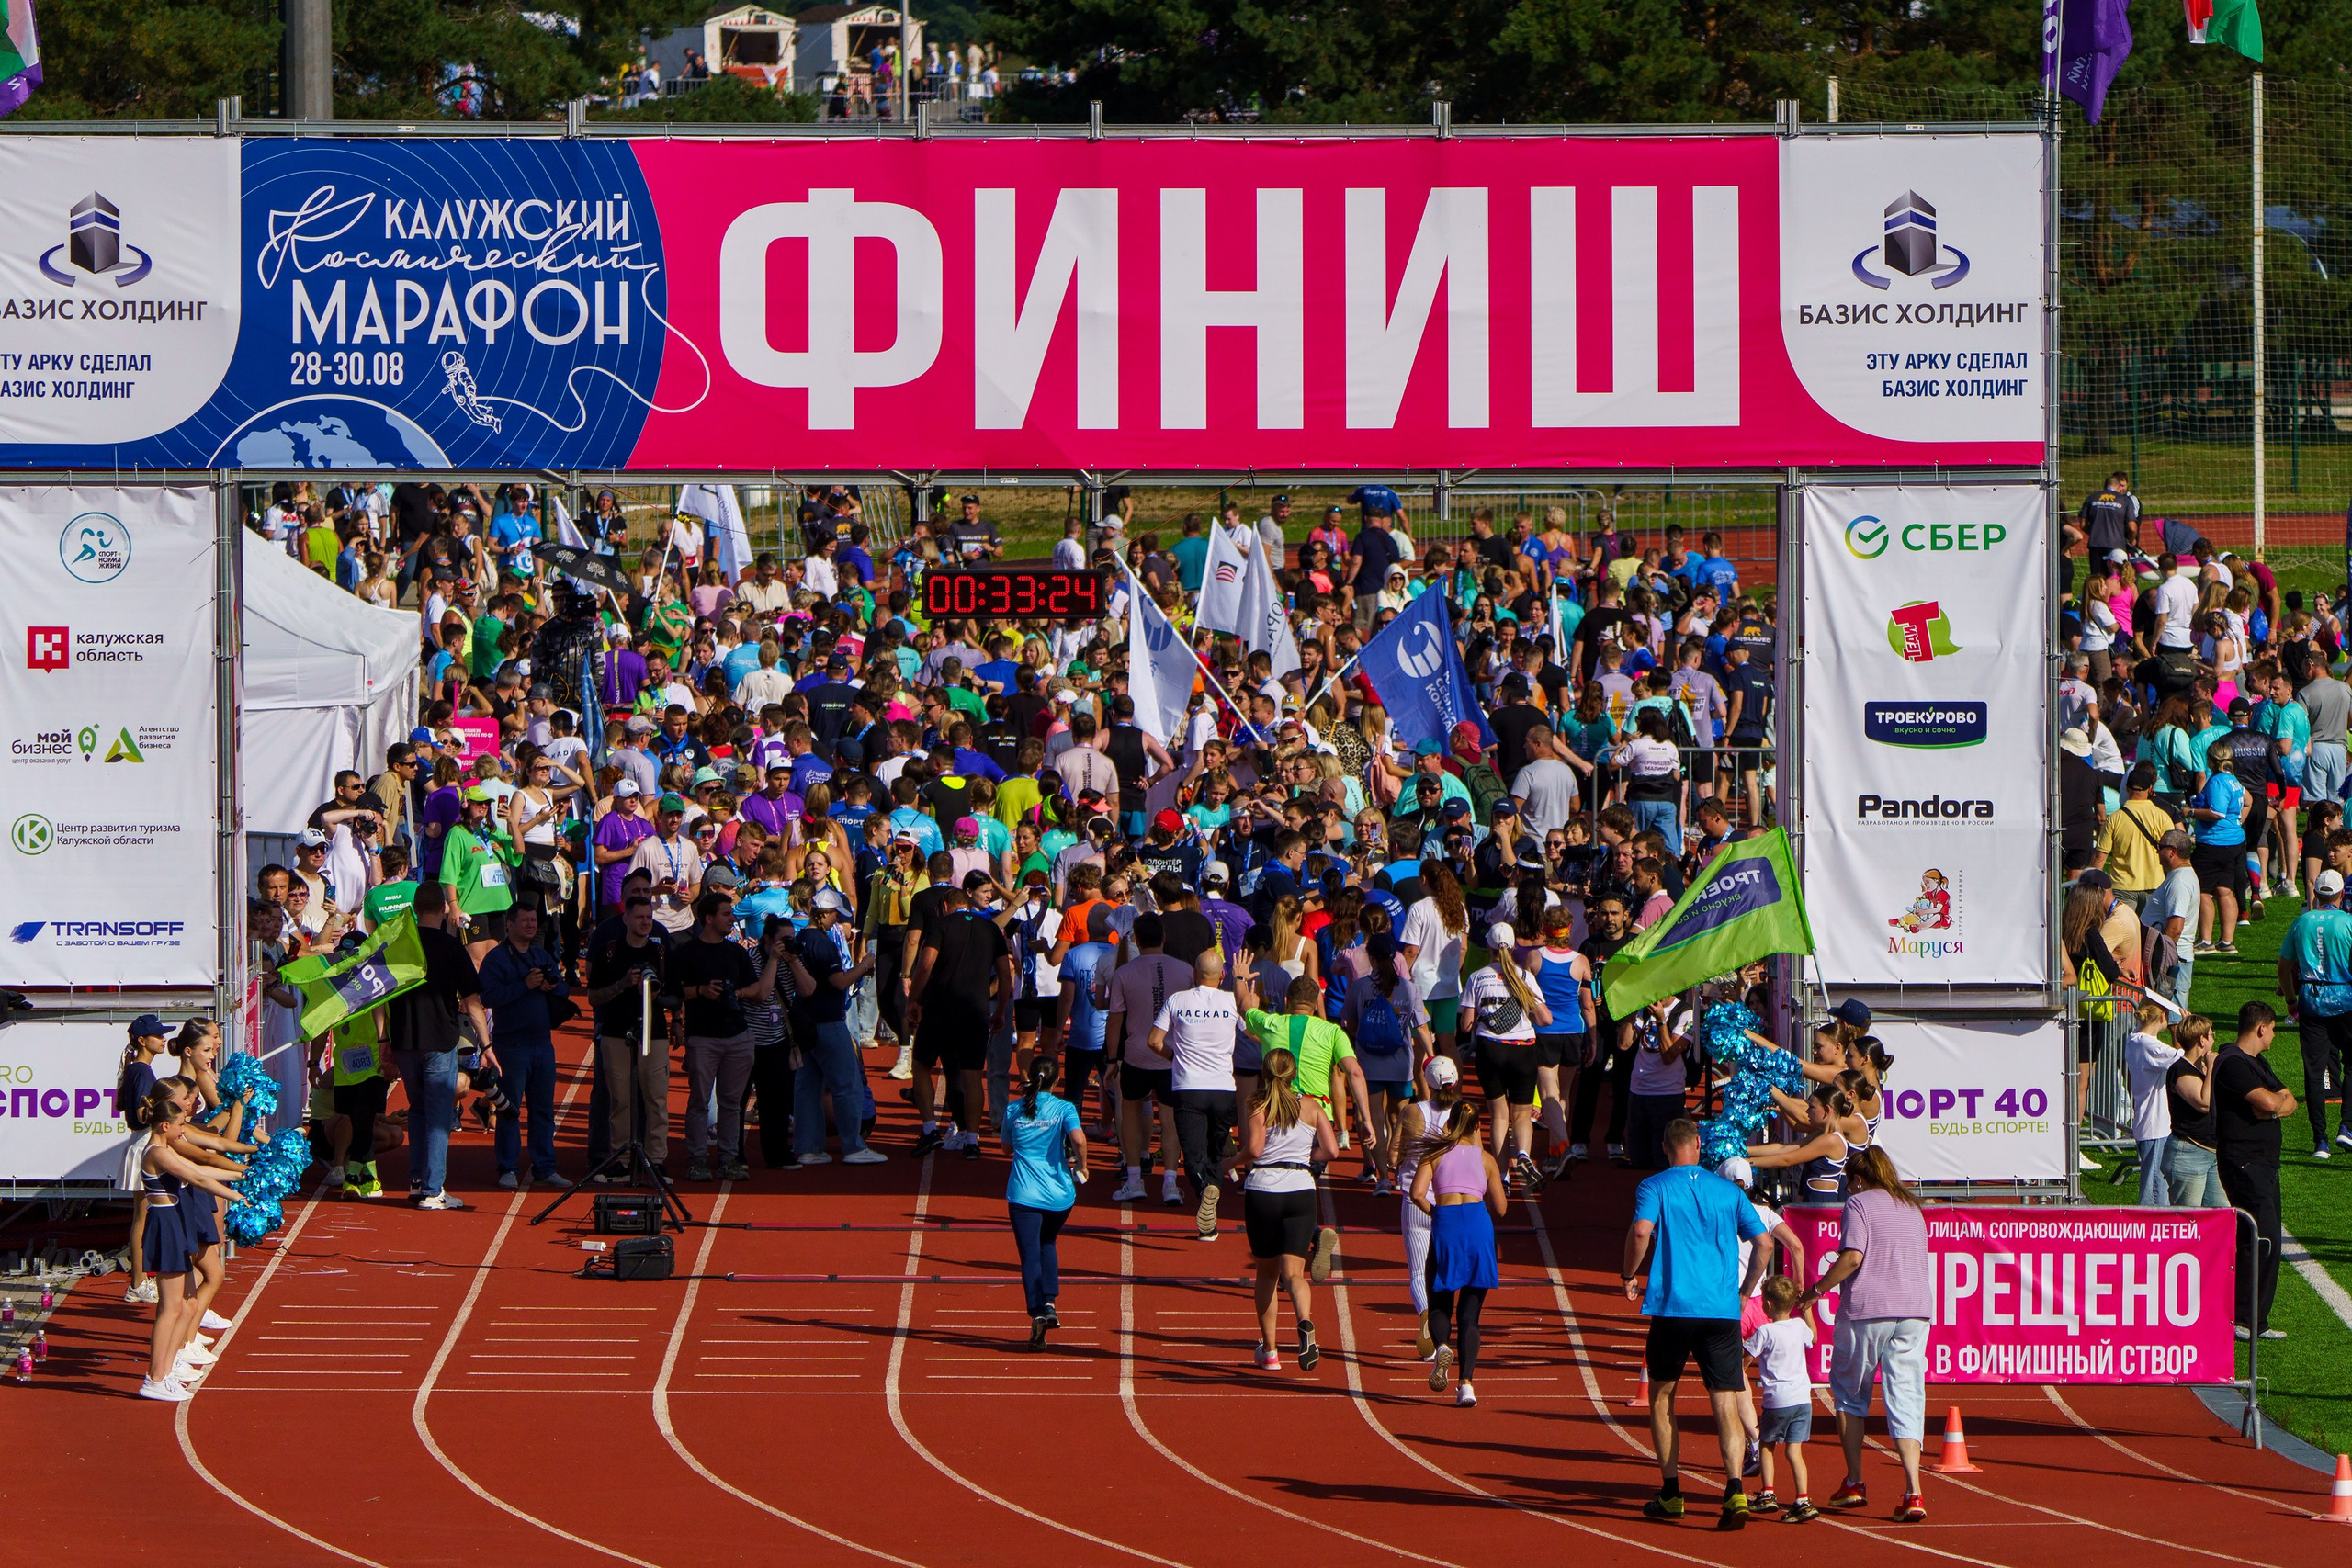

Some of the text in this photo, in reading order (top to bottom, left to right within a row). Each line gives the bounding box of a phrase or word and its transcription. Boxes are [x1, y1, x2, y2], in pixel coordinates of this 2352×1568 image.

[385, 194, 629, 241] КАЛУЖСКИЙ
[81, 300, 208, 325] ХОЛДИНГ
[292, 278, 629, 346] МАРАФОН
[719, 186, 1741, 430] ФИНИШ
[1800, 302, 2029, 327] БАЗИС ХОЛДИНГ
[0, 354, 152, 374] ТУ АРКУ СДЕЛАЛ
[290, 352, 404, 386] 28-30.08
[1866, 352, 2028, 372] ЭТУ АРКУ СДЕЛАЛ
[0, 381, 135, 400] АЗИС ХОЛДИНГ
[1883, 379, 2028, 399] БАЗИС ХОЛДИНГ
[1902, 524, 2007, 551] СБЕР
[929, 575, 1095, 614] 00:33:24
[76, 633, 164, 649] калужская
[76, 648, 143, 661] область
[1875, 708, 1977, 724] ТРОЕКУРОВО
[38, 729, 72, 743] мой
[139, 741, 171, 750] бизнеса
[12, 739, 72, 754] бизнес
[2234, 747, 2267, 757] RUSSIA
[1858, 795, 1994, 818] Pandora
[57, 823, 180, 834] Центр развития туризма
[57, 836, 153, 846] Калужской области
[492, 874, 505, 884] 470
[51, 921, 184, 936] TRANSOFF
[1887, 937, 1963, 958] Маруся
[1156, 963, 1164, 1010] ВИЖЕНИЕМ
[351, 1056, 371, 1069] 4083
[0, 1066, 33, 1083] RO
[0, 1088, 121, 1118] ПОРТ
[1884, 1089, 2049, 1119] ОРТ 40
[74, 1122, 125, 1134] БУДЬ В
[1930, 1122, 2049, 1136] БУДЬ В СПОРТЕ!
[1929, 1220, 2201, 1242] ЛИЦАМ, СОПРОВОЖДАЮЩИМ ДЕТЕЙ,
[1818, 1252, 2201, 1336] ЗРЕЩЕНО
[1936, 1347, 1951, 1373] В
[1958, 1340, 2113, 1375] ФИНИШНЫЙ
[2120, 1345, 2198, 1375] СТВОР
